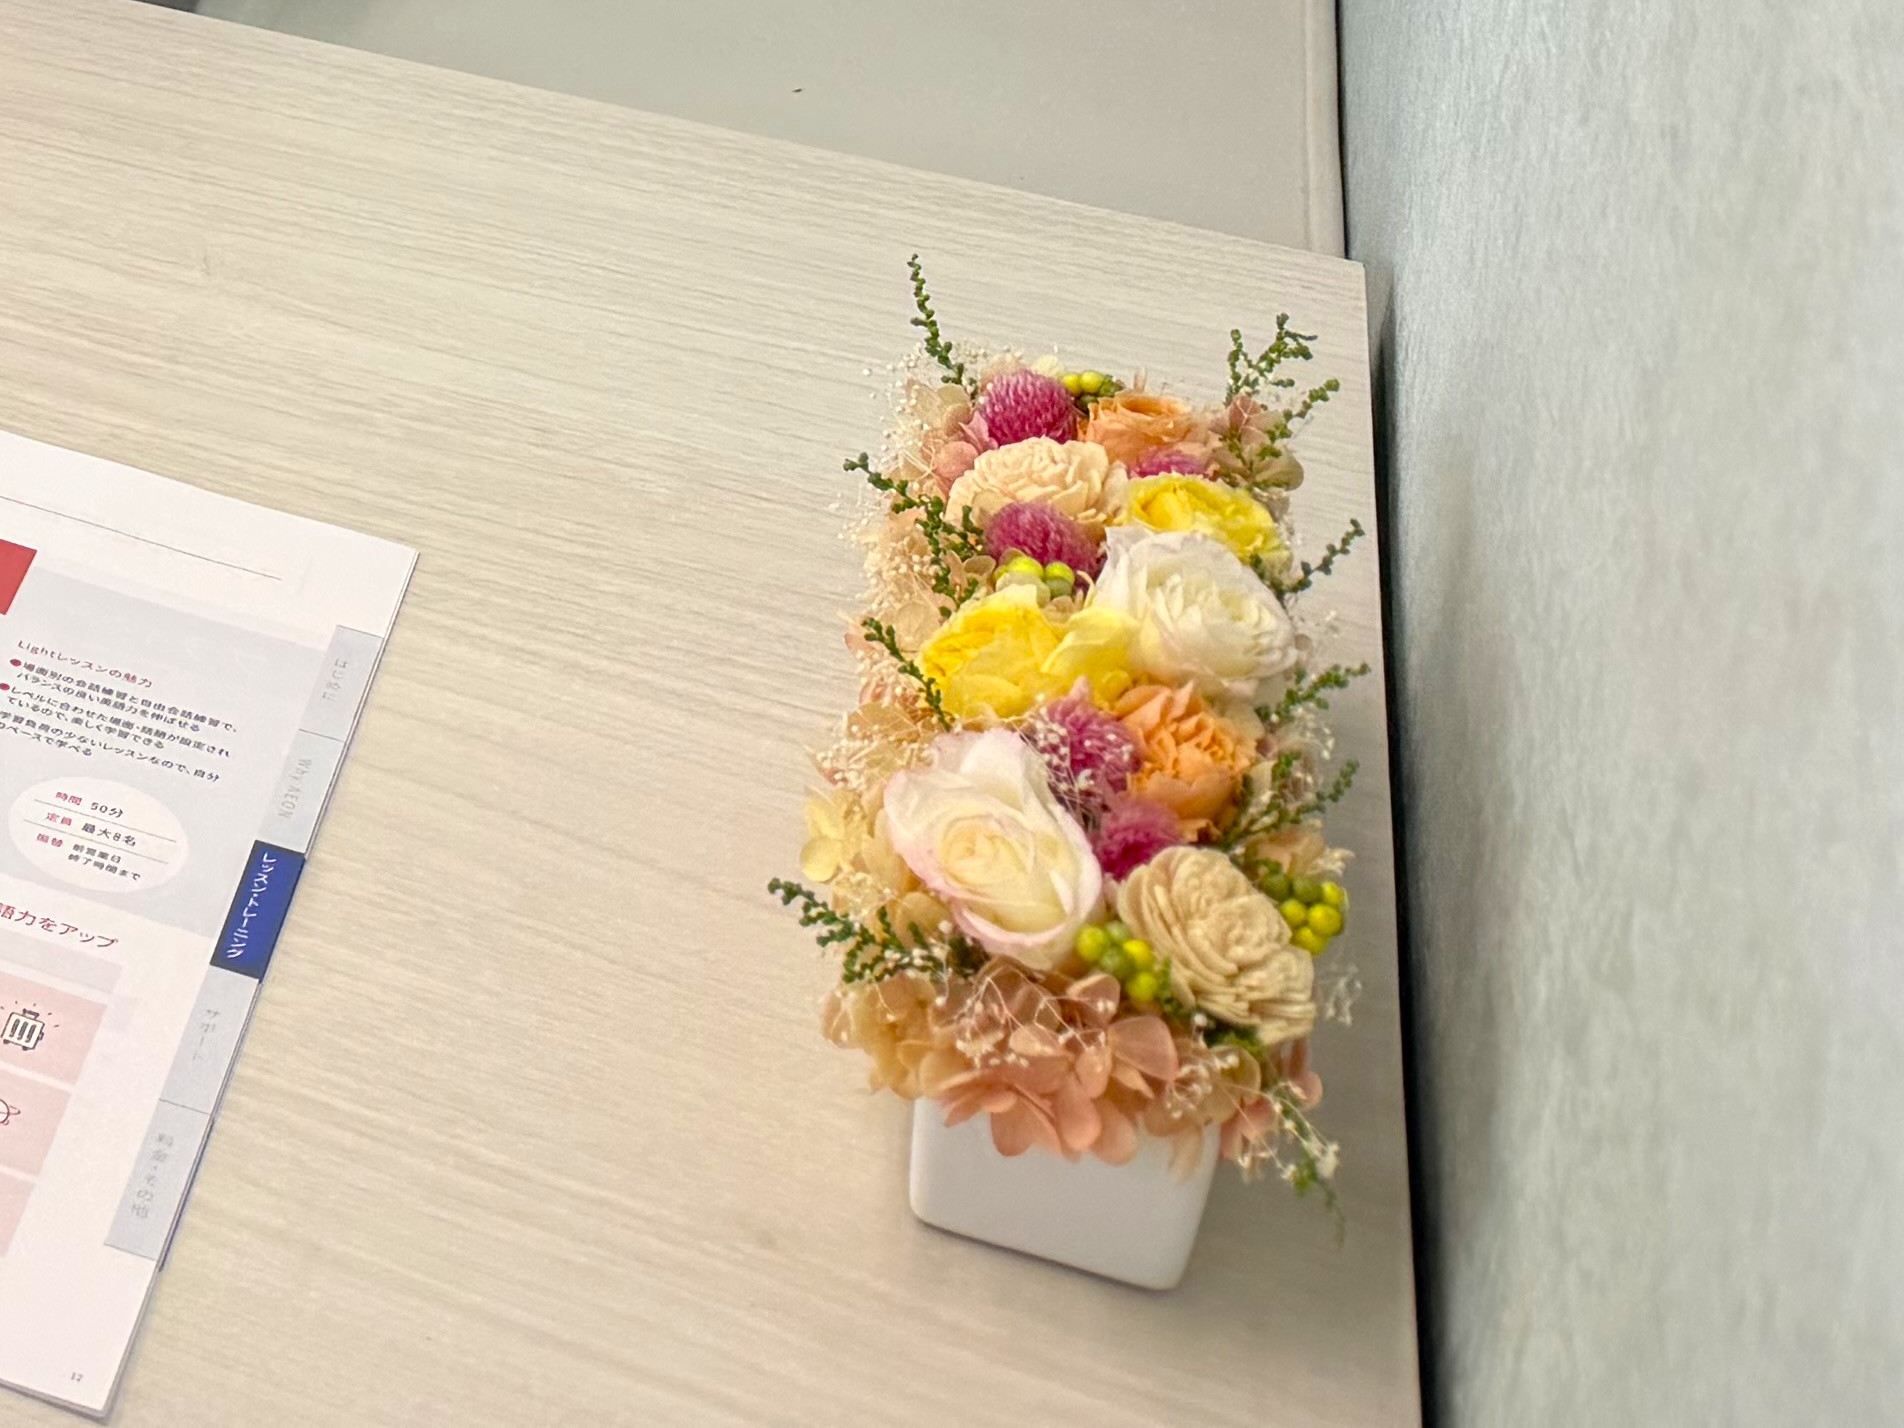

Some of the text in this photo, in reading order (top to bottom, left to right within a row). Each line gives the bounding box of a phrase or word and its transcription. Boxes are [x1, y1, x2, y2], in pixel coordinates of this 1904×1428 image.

[91, 802, 123, 818] 50分
[81, 823, 136, 846] 最大8名
